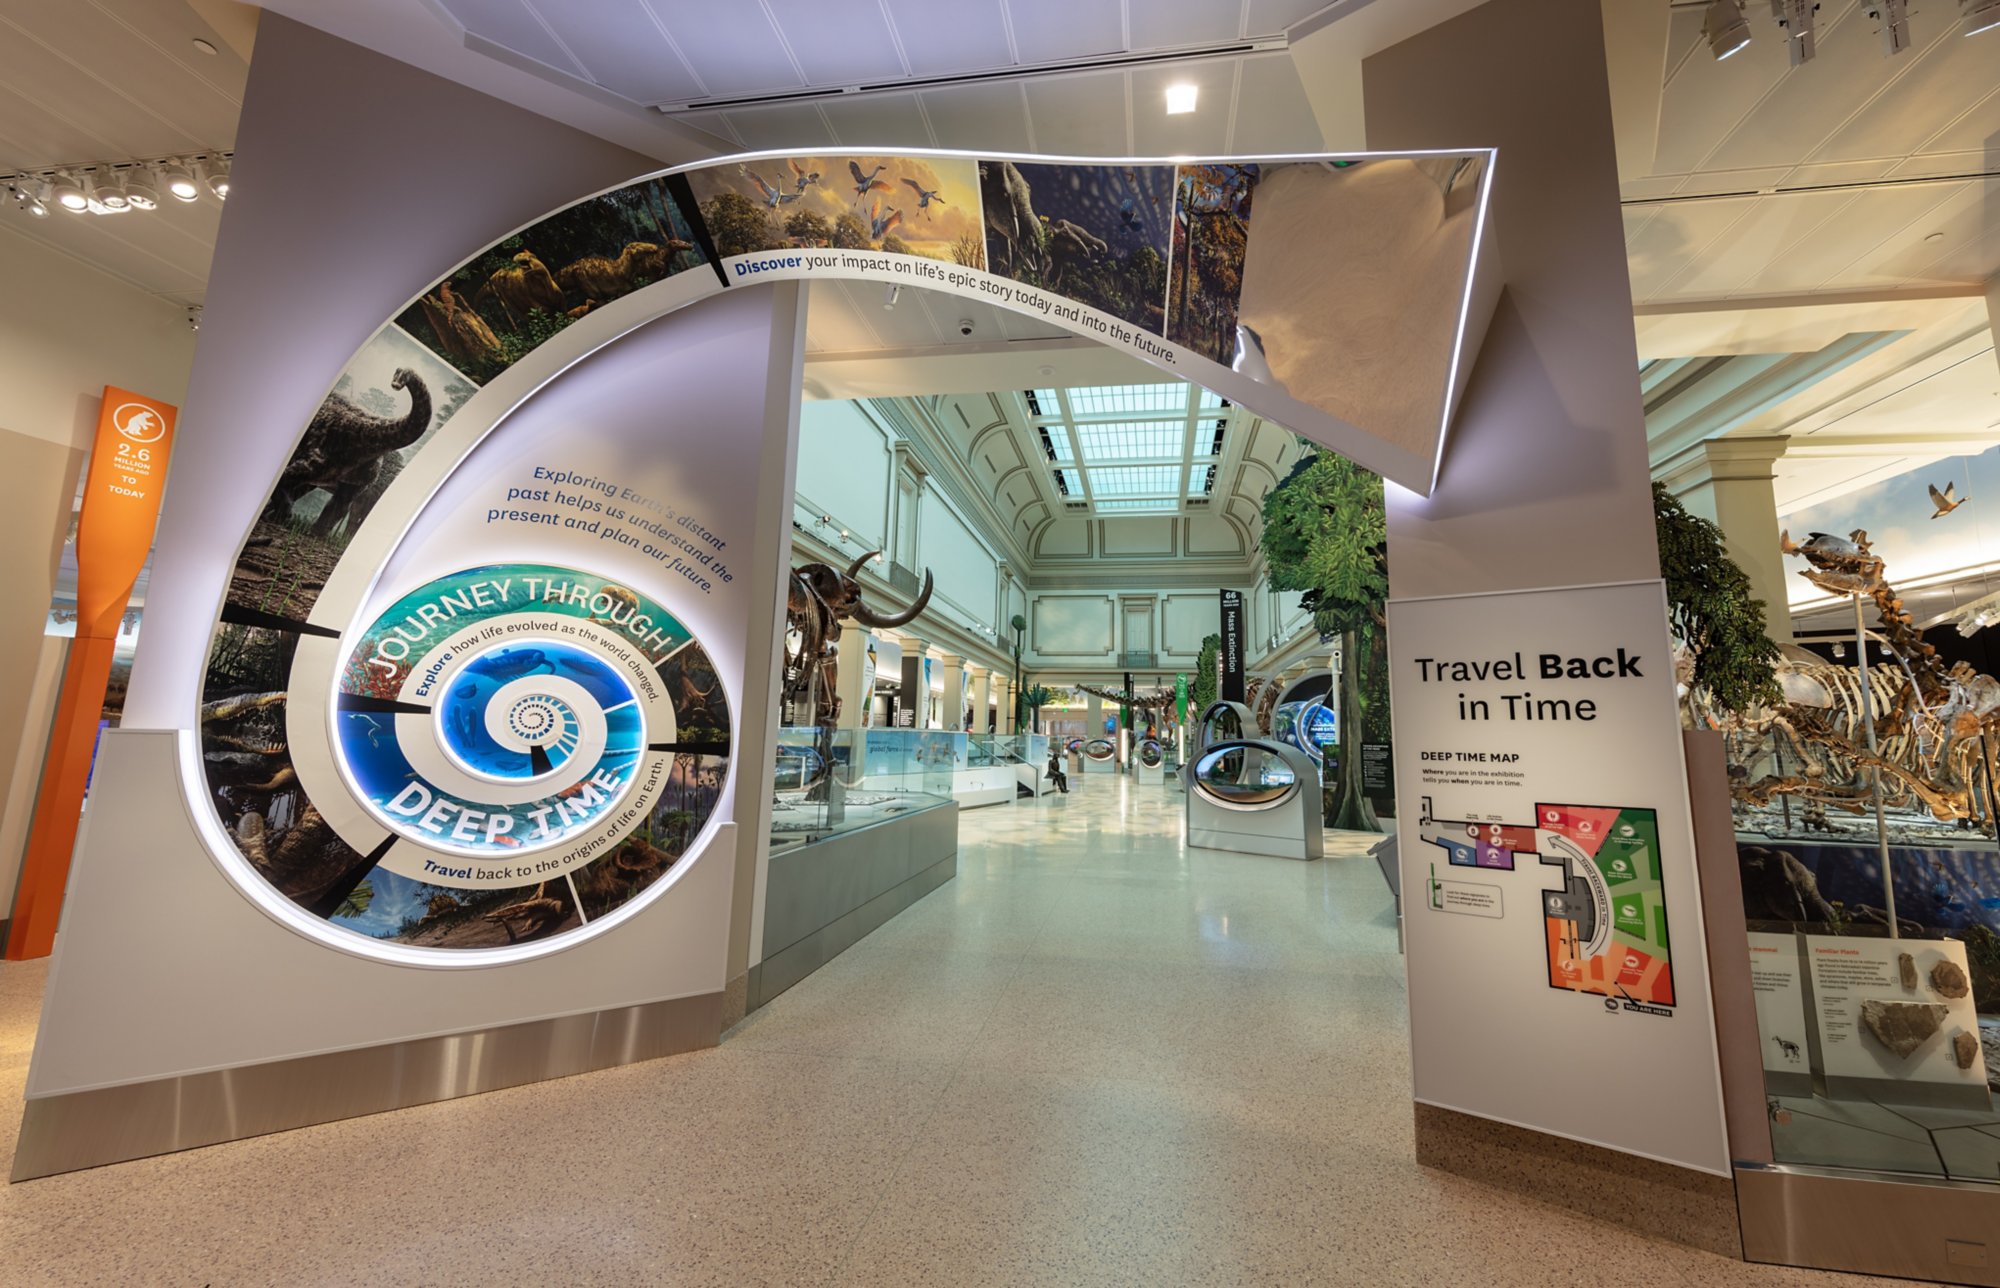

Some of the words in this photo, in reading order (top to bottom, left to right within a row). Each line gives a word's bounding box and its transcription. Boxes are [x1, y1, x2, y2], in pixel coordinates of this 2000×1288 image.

[735, 256, 802, 276] Discover
[806, 255, 838, 270] your
[842, 254, 891, 272] impact
[894, 263, 911, 274] on
[915, 263, 945, 281] life’s
[948, 273, 976, 287] epic
[979, 280, 1013, 300] story
[1015, 289, 1052, 315] today
[1054, 304, 1079, 322] and
[1082, 311, 1107, 333] into
[1110, 324, 1131, 343] the
[1134, 333, 1176, 364] future.
[114, 457, 150, 470] MILLION
[118, 443, 150, 461] 2.6
[109, 484, 145, 499] TODAY
[122, 475, 137, 484] TO
[533, 466, 617, 498] Exploring
[676, 513, 727, 552] distant
[487, 507, 560, 526] present
[564, 517, 601, 534] and
[600, 526, 641, 549] plan
[642, 544, 671, 562] our
[665, 557, 712, 594] future.
[507, 486, 550, 501] past
[554, 490, 603, 513] helps
[605, 505, 626, 520] us
[628, 513, 714, 566] understand
[714, 553, 733, 584] the
[1225, 592, 1237, 600] 66
[368, 578, 512, 679] JOURNEY
[522, 578, 672, 652] THROUGH
[1228, 611, 1236, 632] Mass
[416, 652, 453, 697] Explore
[450, 635, 480, 654] how
[481, 626, 504, 640] life
[507, 621, 558, 632] evolved
[561, 624, 576, 635] as
[578, 628, 599, 642] the
[599, 638, 629, 662] world
[627, 661, 659, 703] changed.
[1228, 633, 1237, 673] Extinction
[1414, 652, 1526, 682] Travel
[1539, 648, 1645, 680] Back
[1458, 692, 1490, 721] in
[1500, 691, 1597, 721] Time
[1421, 751, 1453, 761] DEEP
[1455, 752, 1487, 762] TIME
[1490, 753, 1520, 763] MAP
[385, 780, 514, 843] DEEP
[527, 768, 622, 837] TIME
[424, 860, 472, 879] Travel
[476, 867, 512, 880] back
[516, 867, 532, 877] to
[536, 859, 560, 873] the
[563, 835, 607, 864] origins
[606, 822, 620, 838] of
[616, 809, 638, 827] life
[634, 794, 649, 809] on
[643, 758, 664, 793] Earth.
[1592, 873, 1605, 905] BACKWARD
[1653, 1008, 1671, 1016] HERE
